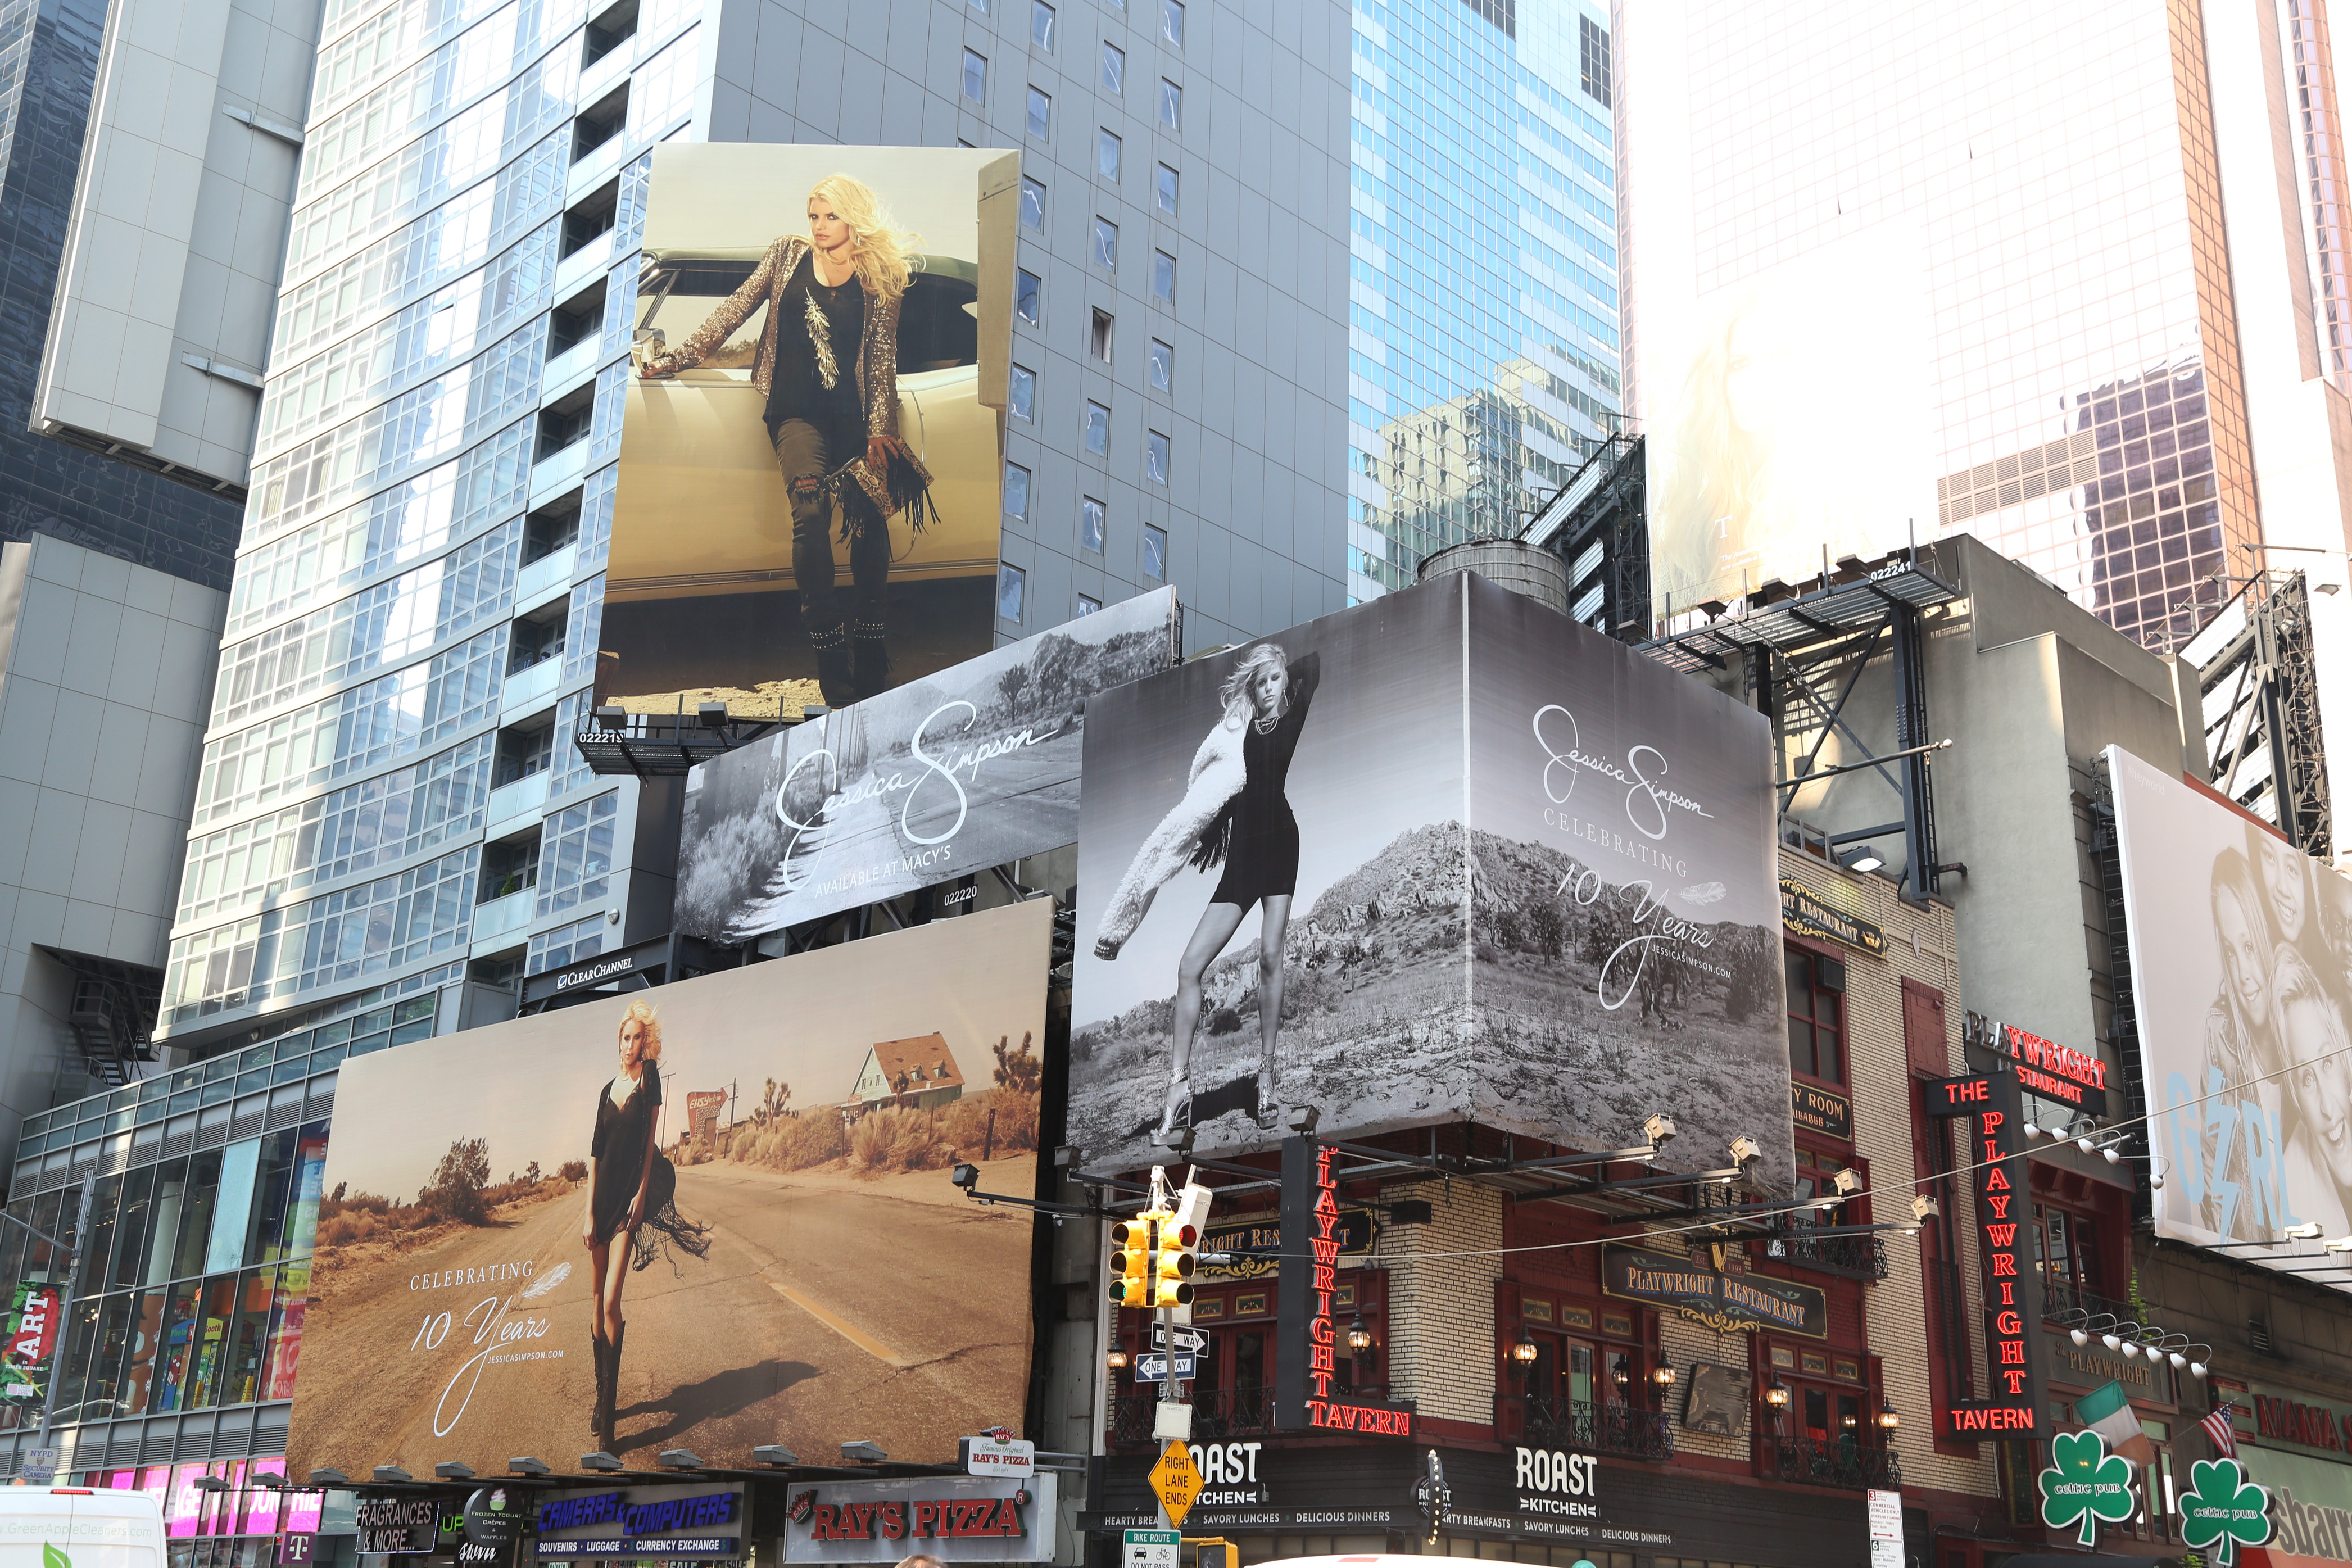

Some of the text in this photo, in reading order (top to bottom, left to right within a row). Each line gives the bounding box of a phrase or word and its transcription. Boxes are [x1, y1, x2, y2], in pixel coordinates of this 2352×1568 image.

[1870, 560, 1911, 581] 022241
[1533, 704, 1715, 840] Jessica Simpson
[776, 700, 1058, 890] Jessica Simpson
[1544, 808, 1687, 877] CELEBRATING
[815, 845, 950, 898] AVAILABLE AT MACY'S
[944, 885, 977, 906] 022220
[1799, 896, 1858, 942] RESTAURANT
[1557, 863, 1715, 1010] 10 Years
[1652, 944, 1732, 980] JESSICASIMPSON.COM
[1965, 1009, 2106, 1090] PLAYWRIGHT
[1945, 1080, 1990, 1104] THE
[1809, 1093, 1843, 1121] ROOM
[1982, 1111, 2027, 1394] PLAYWRIGHT
[410, 1261, 533, 1291] CELEBRATING
[1695, 1255, 1742, 1274] Est. 1993
[1628, 1267, 1805, 1325] PLAYWRIGHT RESTAURANT
[17, 1291, 49, 1359] ART
[171, 1328, 187, 1336] Photo
[1184, 1335, 1200, 1347] WAY
[2056, 1341, 2068, 1357] The
[411, 1294, 551, 1437] 10 Years
[488, 1350, 564, 1364] JESSICASIMPSON.COM
[1145, 1361, 1188, 1372] ONE AY
[2068, 1351, 2150, 1386] PLAYWRIGHT
[1305, 1401, 1411, 1436] TAVERN
[1951, 1408, 2034, 1430] TAVERN
[972, 1453, 1030, 1466] RAY'S PIZZA
[980, 1443, 1025, 1454] Famous Original
[1165, 1456, 1190, 1470] RIGHT
[1188, 1443, 1261, 1484] OAST
[1516, 1446, 1597, 1497] ROAST
[1165, 1475, 1189, 1488] LANE
[1166, 1492, 1188, 1506] ENDS
[1195, 1490, 1245, 1506] TCHEN
[1869, 1491, 1875, 1500] 3
[355, 1502, 432, 1527] FRAGRANCES
[538, 1492, 733, 1535] CAMERAS & COMPUTERS
[793, 1498, 809, 1518] RAY'S
[811, 1498, 1025, 1540] RAY'S PIZZA
[1105, 1516, 1136, 1526] HEARTY
[1203, 1515, 1237, 1524] SAVORY
[1239, 1513, 1280, 1523] LUNCHES
[1296, 1512, 1345, 1523] DELICIOUS
[1348, 1511, 1390, 1522] DINNERS
[1530, 1498, 1588, 1517] KITCHEN
[364, 1529, 415, 1551] & MORE...
[1134, 1533, 1171, 1542] BIKE ROUTE
[1463, 1515, 1511, 1529] BREAKFASTS
[1524, 1521, 1555, 1533] SAVORY
[1555, 1524, 1589, 1537] LUNCHES
[1602, 1529, 1639, 1541] DELICIOUS
[1640, 1531, 1671, 1544] DINNERS
[538, 1542, 578, 1552] SOUVENIRS
[586, 1540, 620, 1552] LUGGAGE
[636, 1540, 677, 1552] CURRENCY
[677, 1539, 720, 1551] EXCHANGE
[1872, 1541, 1878, 1550] 6
